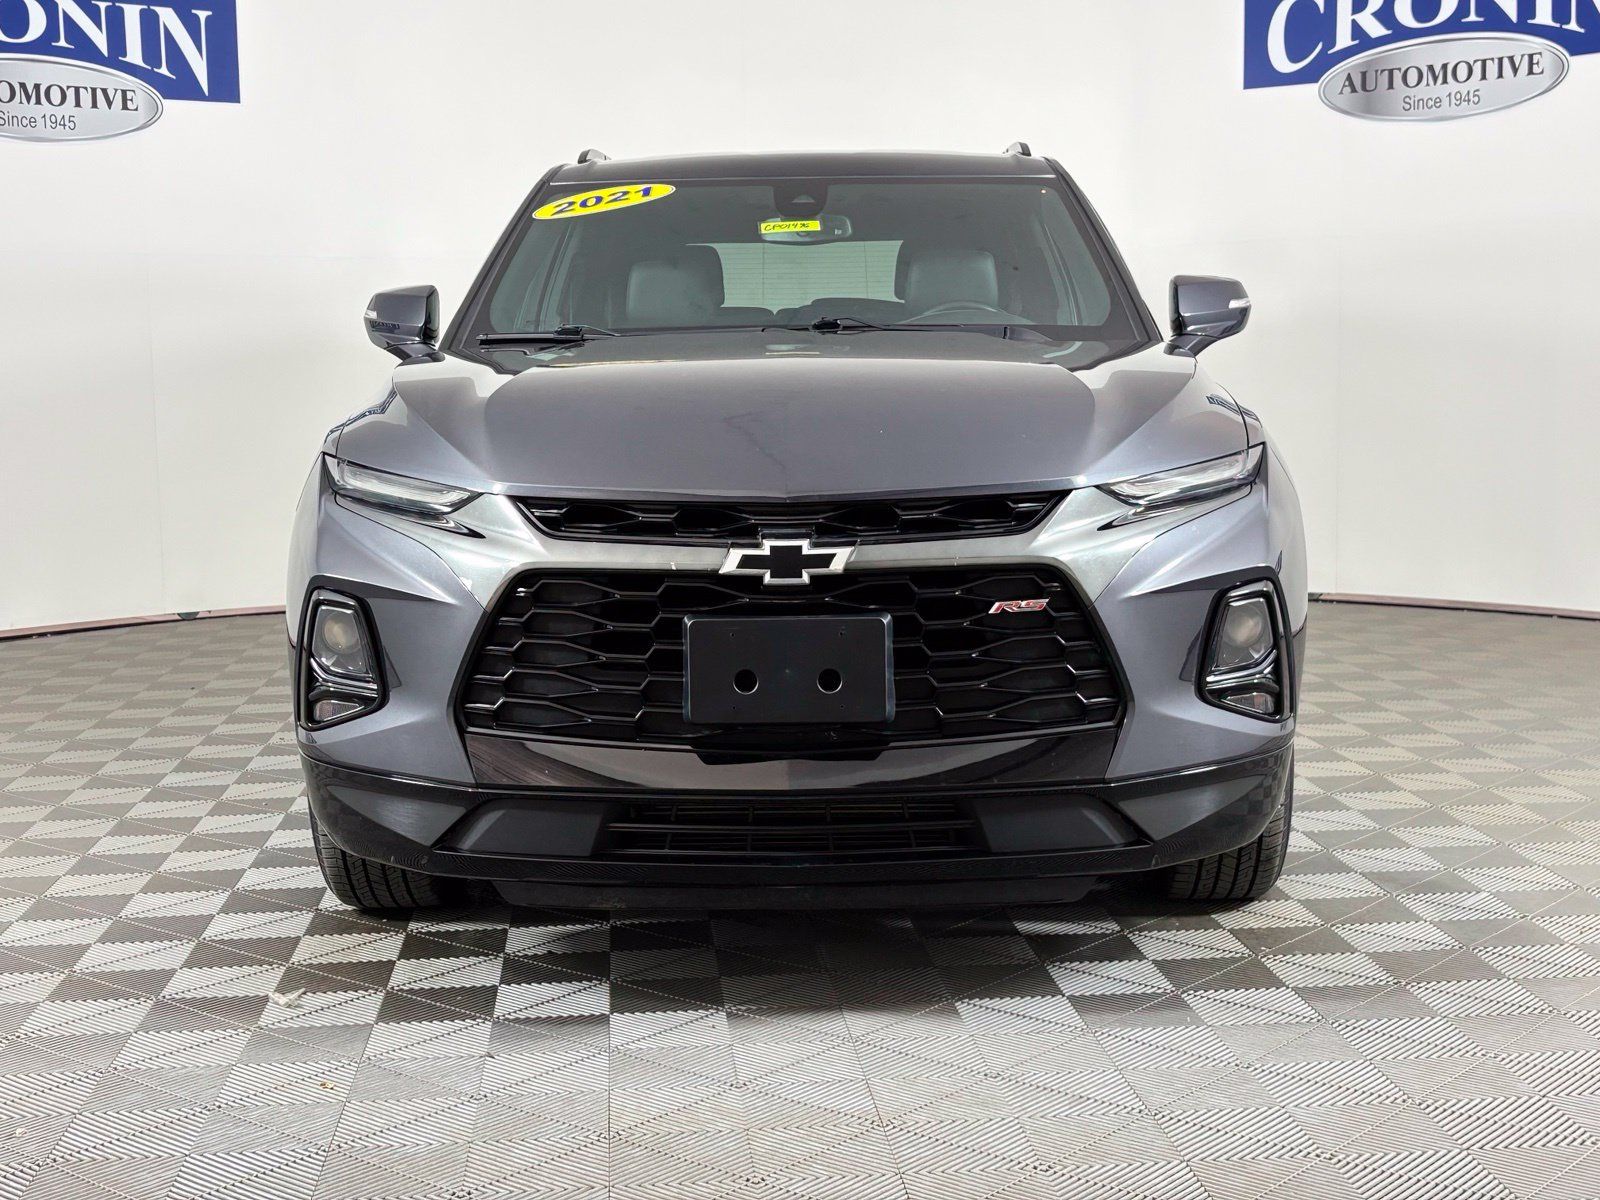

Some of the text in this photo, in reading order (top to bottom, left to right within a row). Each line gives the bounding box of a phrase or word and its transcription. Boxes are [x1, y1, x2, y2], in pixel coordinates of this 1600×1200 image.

[1267, 0, 1600, 74] CRO
[1338, 51, 1545, 95] AUTOMOTIVE
[1402, 88, 1481, 112] Since 1945
[41, 112, 77, 131] 1945
[551, 186, 651, 217] 2021
[988, 598, 1049, 614] RS
